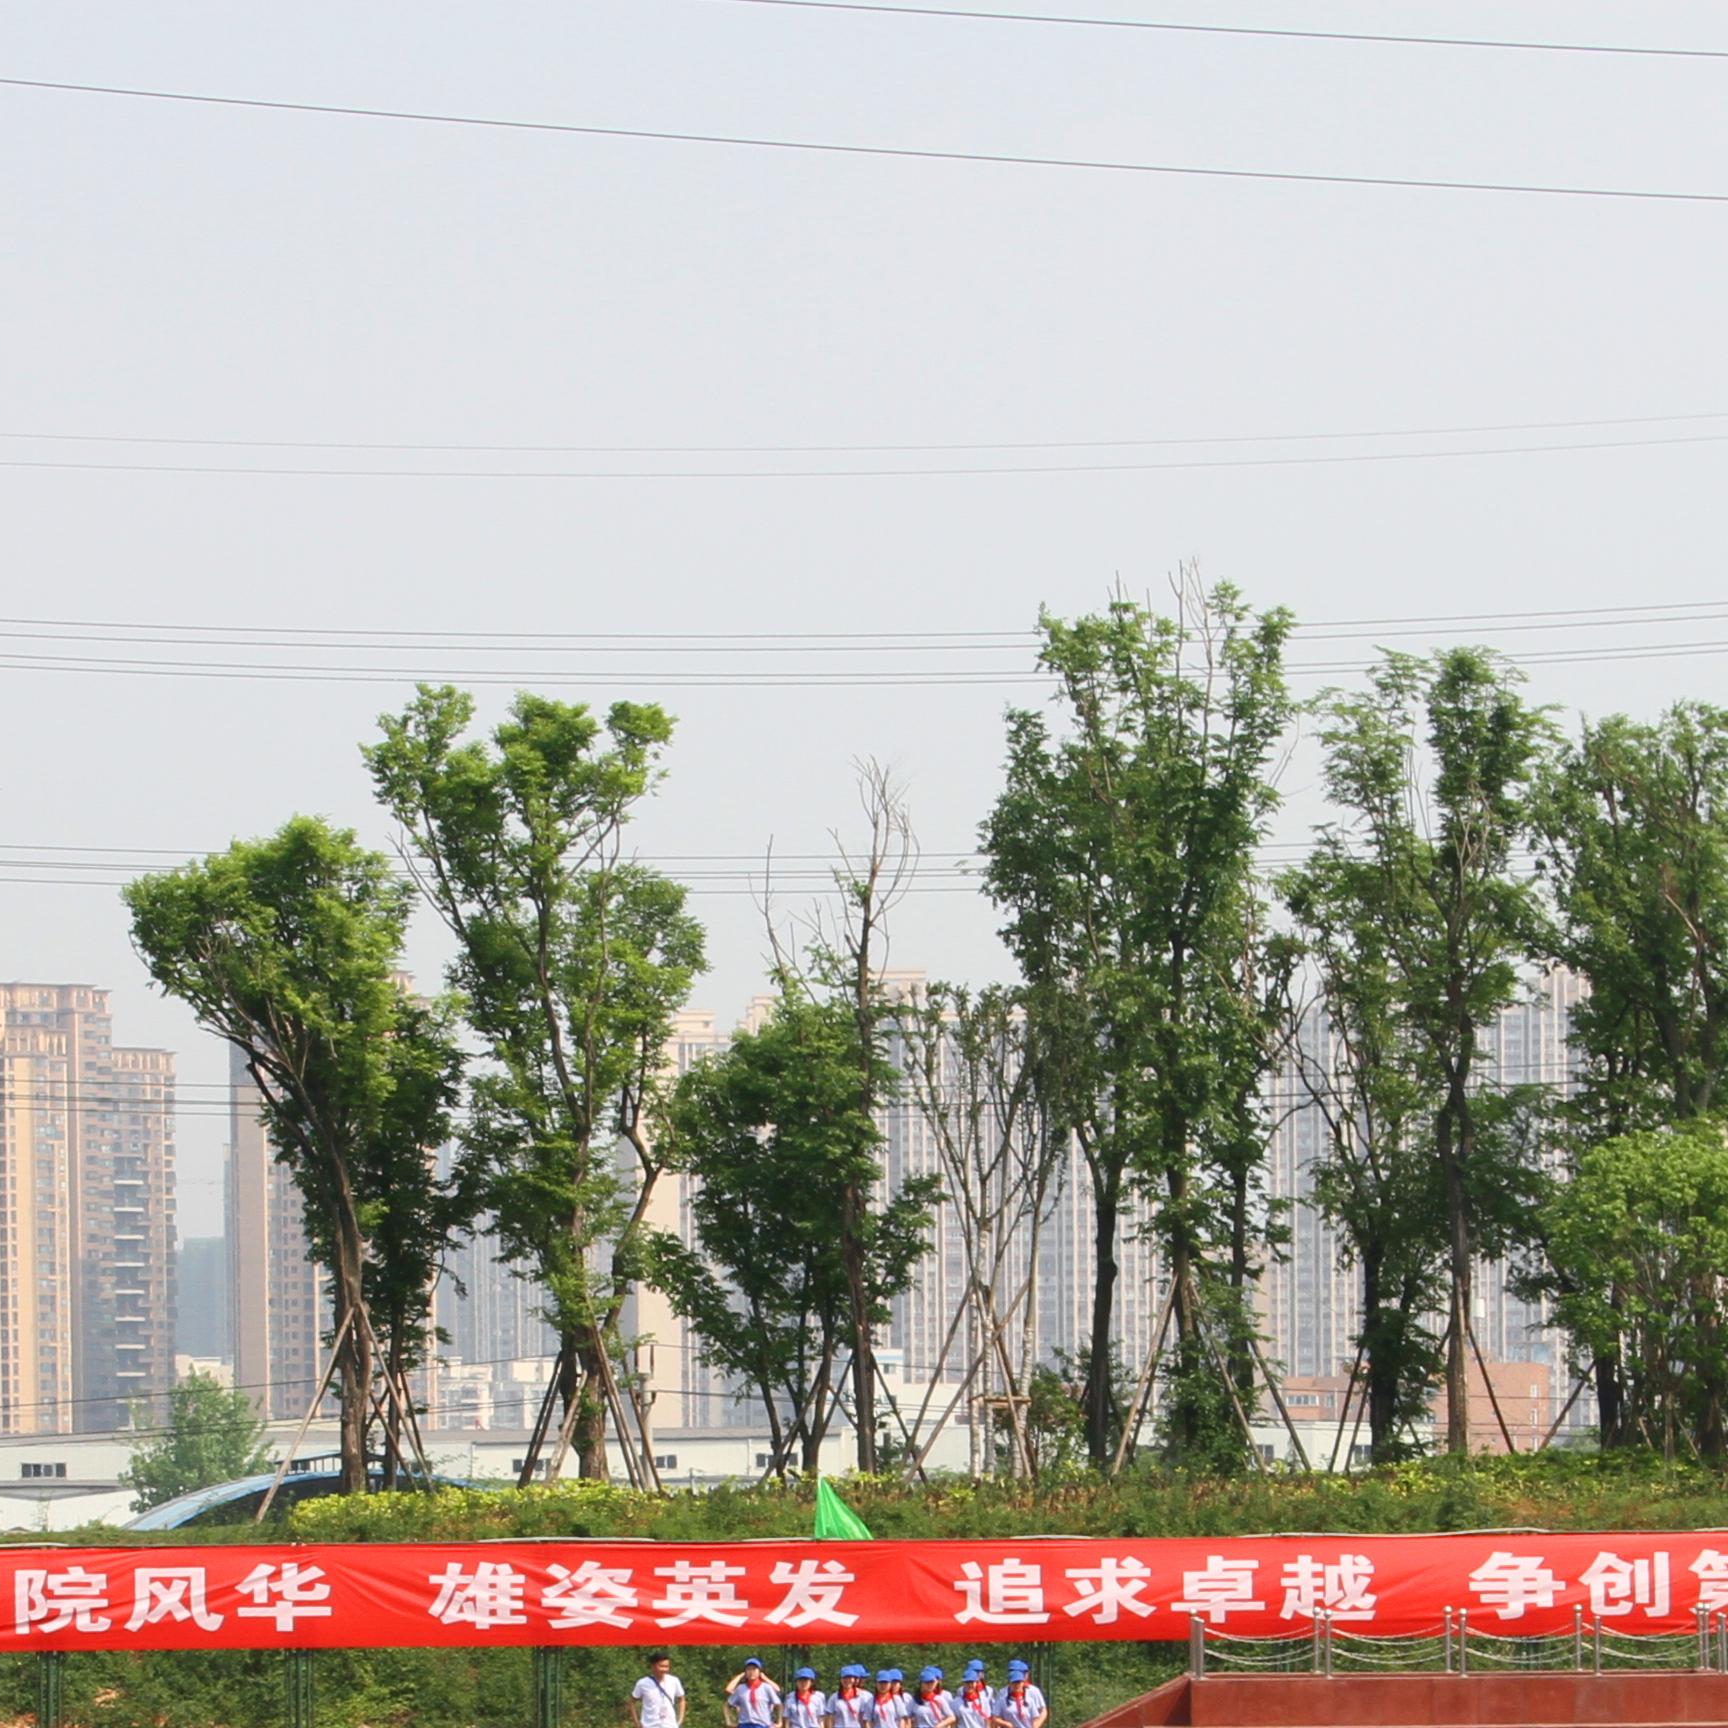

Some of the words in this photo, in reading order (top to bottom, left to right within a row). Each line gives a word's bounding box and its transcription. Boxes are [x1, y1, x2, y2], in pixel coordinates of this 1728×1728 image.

[427, 1559, 860, 1630] 雄姿英发
[953, 1553, 1378, 1625] 追求卓越
